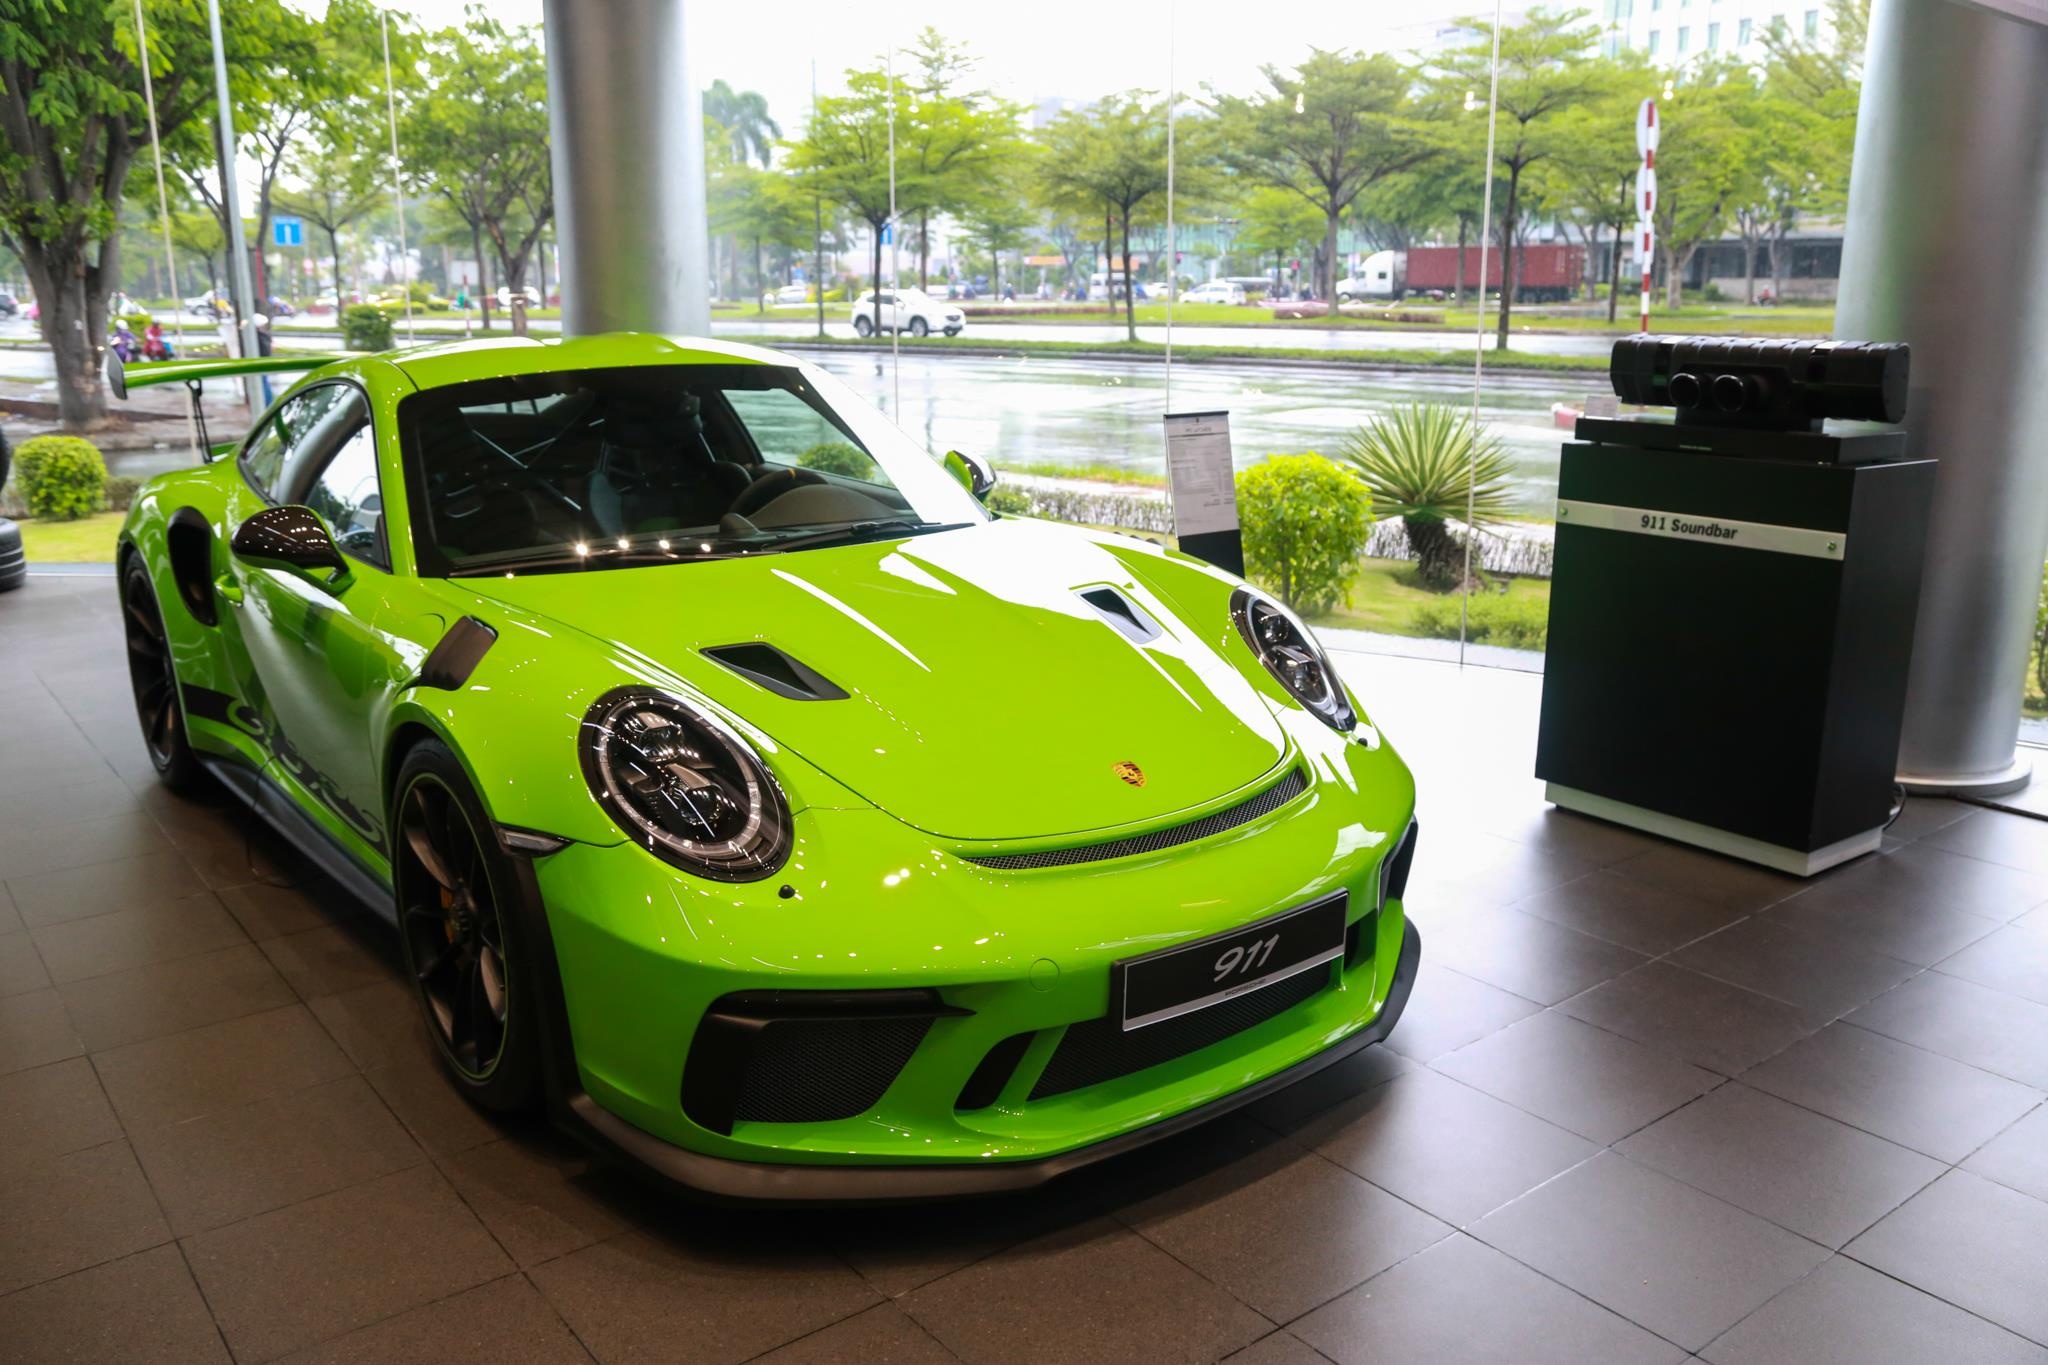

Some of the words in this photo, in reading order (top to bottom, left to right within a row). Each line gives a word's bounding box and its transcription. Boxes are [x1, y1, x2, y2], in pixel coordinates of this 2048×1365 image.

[1641, 514, 1666, 530] 911
[1671, 518, 1737, 539] Soundbar
[1214, 934, 1280, 982] 911
